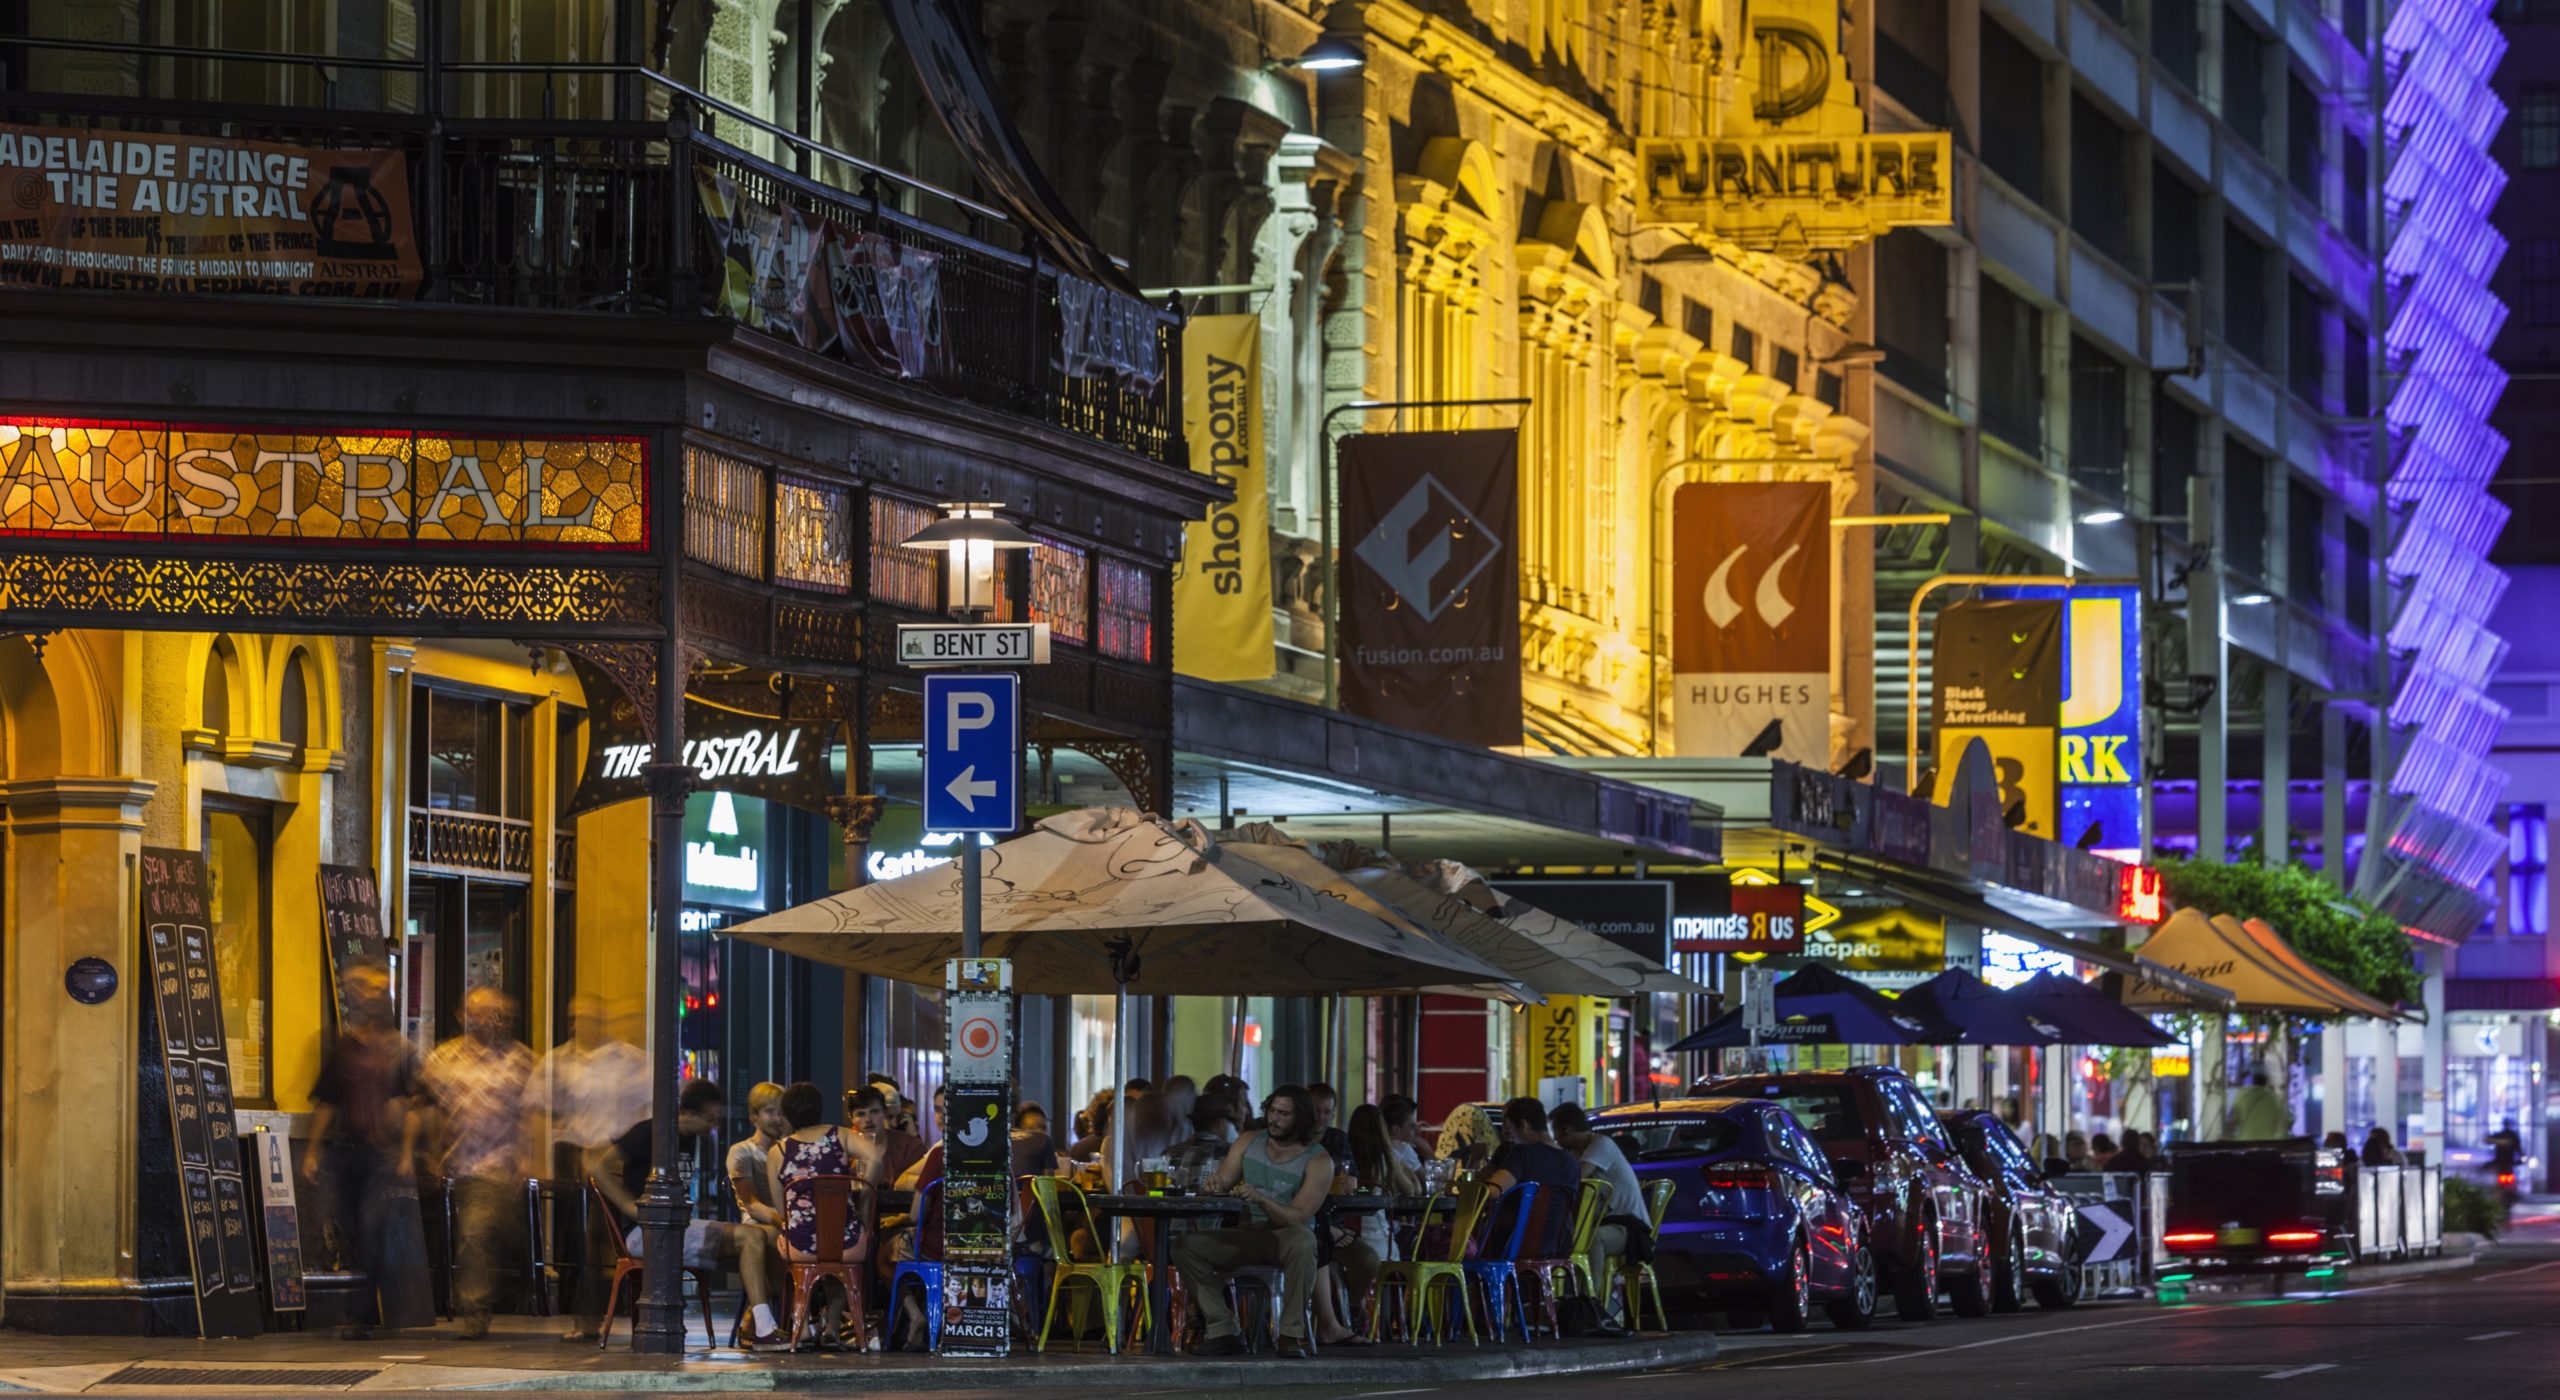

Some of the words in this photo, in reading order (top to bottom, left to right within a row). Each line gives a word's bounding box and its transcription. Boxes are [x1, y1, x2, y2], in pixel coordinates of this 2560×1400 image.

[0, 132, 176, 178] ADELAIDE
[188, 146, 309, 190] FRINGE
[1646, 143, 1939, 194] FURNITURE
[45, 172, 118, 209] THE
[132, 178, 308, 221] AUSTRAL
[15, 219, 40, 238] THE
[71, 217, 85, 238] OF
[89, 217, 112, 238] THE
[115, 216, 161, 238] FRINGE
[166, 236, 186, 254] THE
[228, 234, 244, 252] OF
[246, 233, 270, 251] THE
[274, 232, 316, 250] FRINGE
[2, 244, 33, 261] DAILY
[33, 247, 64, 265] SHOWS
[64, 250, 134, 271] THROUGHOUT
[137, 256, 157, 274] THE
[160, 258, 196, 276] FRINGE
[199, 259, 242, 276] MIDDAY
[245, 260, 259, 276] TO
[261, 261, 314, 279] MIDNIGHT
[319, 261, 404, 279] AUSTRAL
[0, 432, 597, 527] AUSTRAL
[934, 632, 986, 656] BENT
[996, 631, 1022, 656] ST
[1356, 642, 1504, 665] fusion.com.au
[1691, 684, 1811, 706] HUGHES
[1944, 686, 1985, 700] Black
[1944, 700, 1987, 713] Sheep
[1944, 709, 2026, 725] Advertising
[947, 691, 995, 751] P
[602, 743, 656, 779] THE
[682, 728, 802, 780] USTRAL
[1592, 1122, 1632, 1131] COLORADO
[1631, 1120, 1657, 1128] STATE
[1657, 1119, 1707, 1127] UNIVERSITY
[947, 1183, 1005, 1198] DINOSAUR
[985, 1192, 1005, 1200] ZOO
[946, 1324, 994, 1337] MARCH
[996, 1326, 1005, 1338] 3
